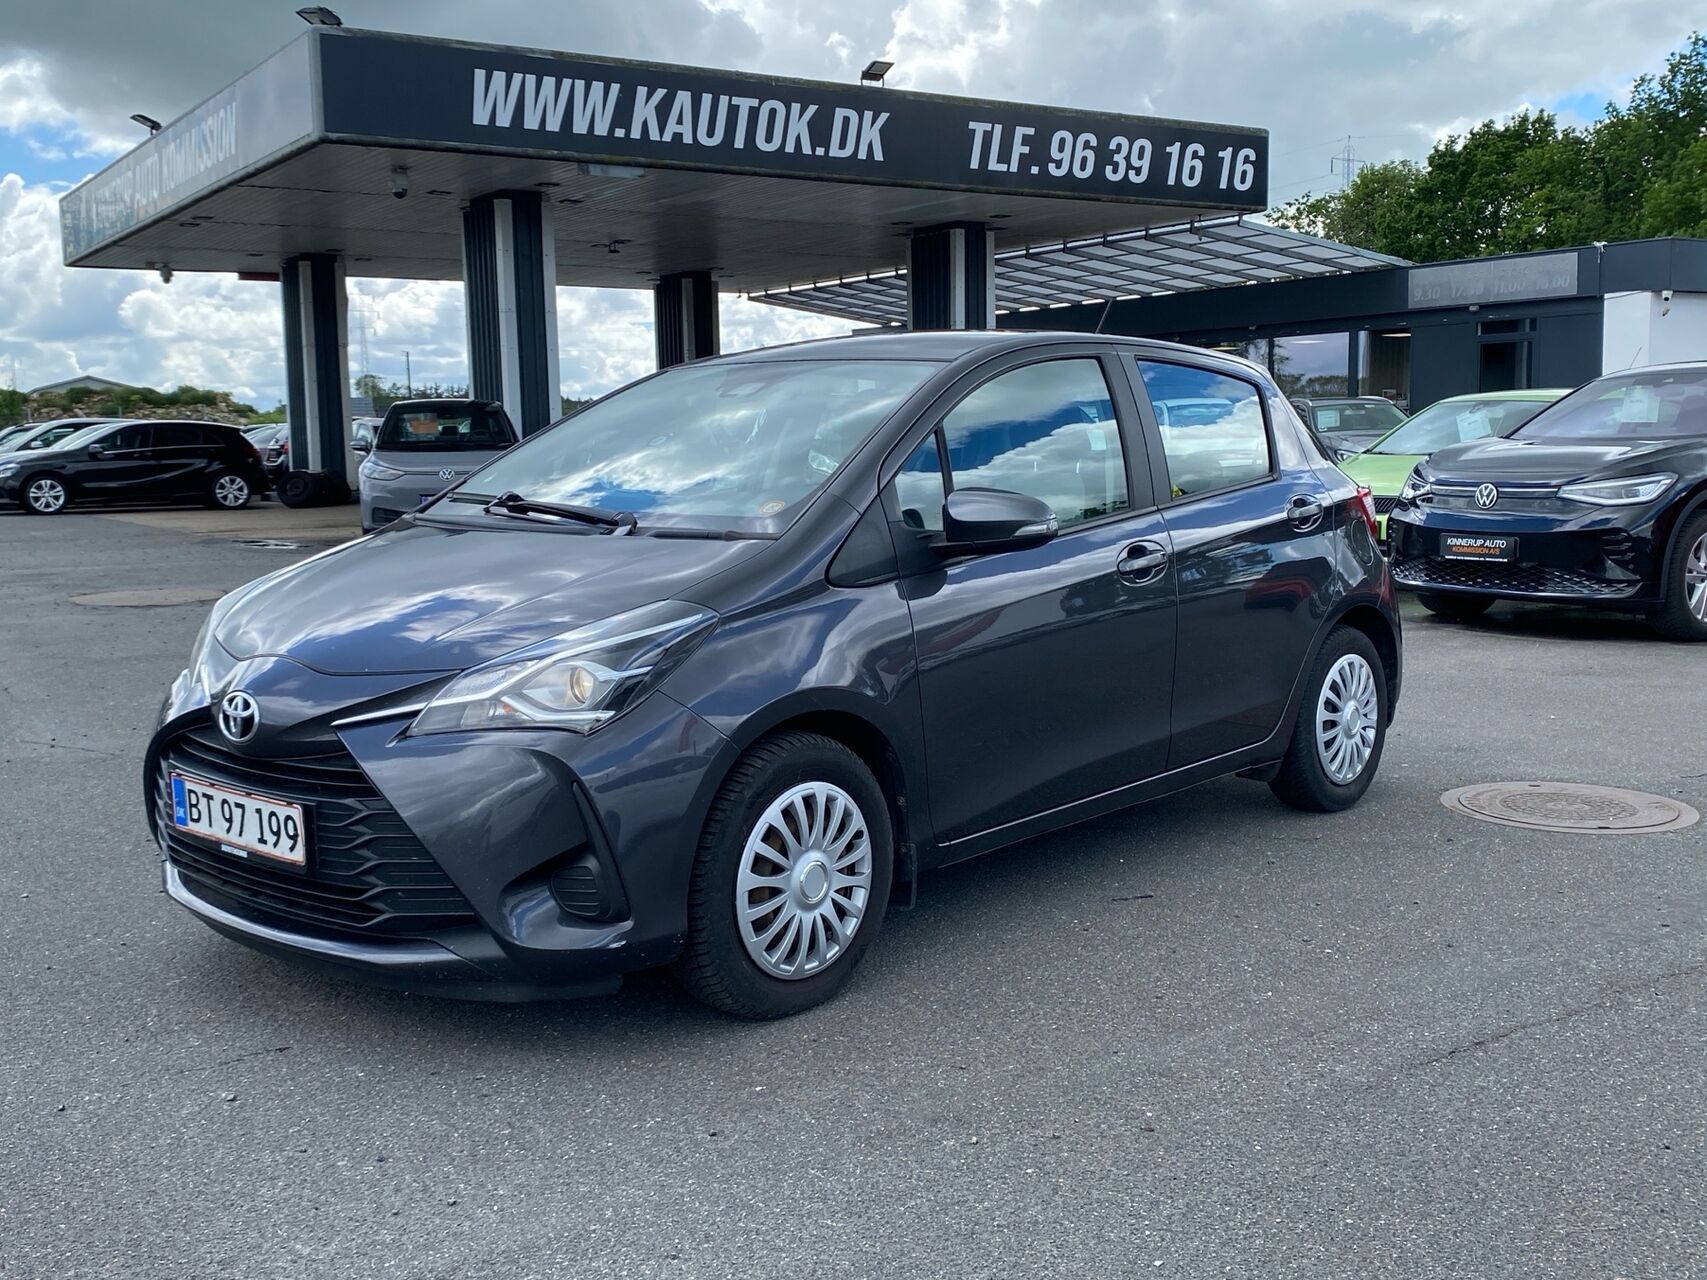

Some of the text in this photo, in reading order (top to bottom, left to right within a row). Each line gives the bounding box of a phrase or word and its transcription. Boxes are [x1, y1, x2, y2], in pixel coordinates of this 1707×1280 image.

[162, 101, 237, 194] KOMMISSION
[472, 68, 1257, 191] WWW.KAUTOK.DK TLF. 96 39 16 16
[1447, 537, 1507, 548] KINNERUP AUTO
[1452, 546, 1500, 555] KOMMISSION A/S
[187, 788, 299, 853] BT 97 199
